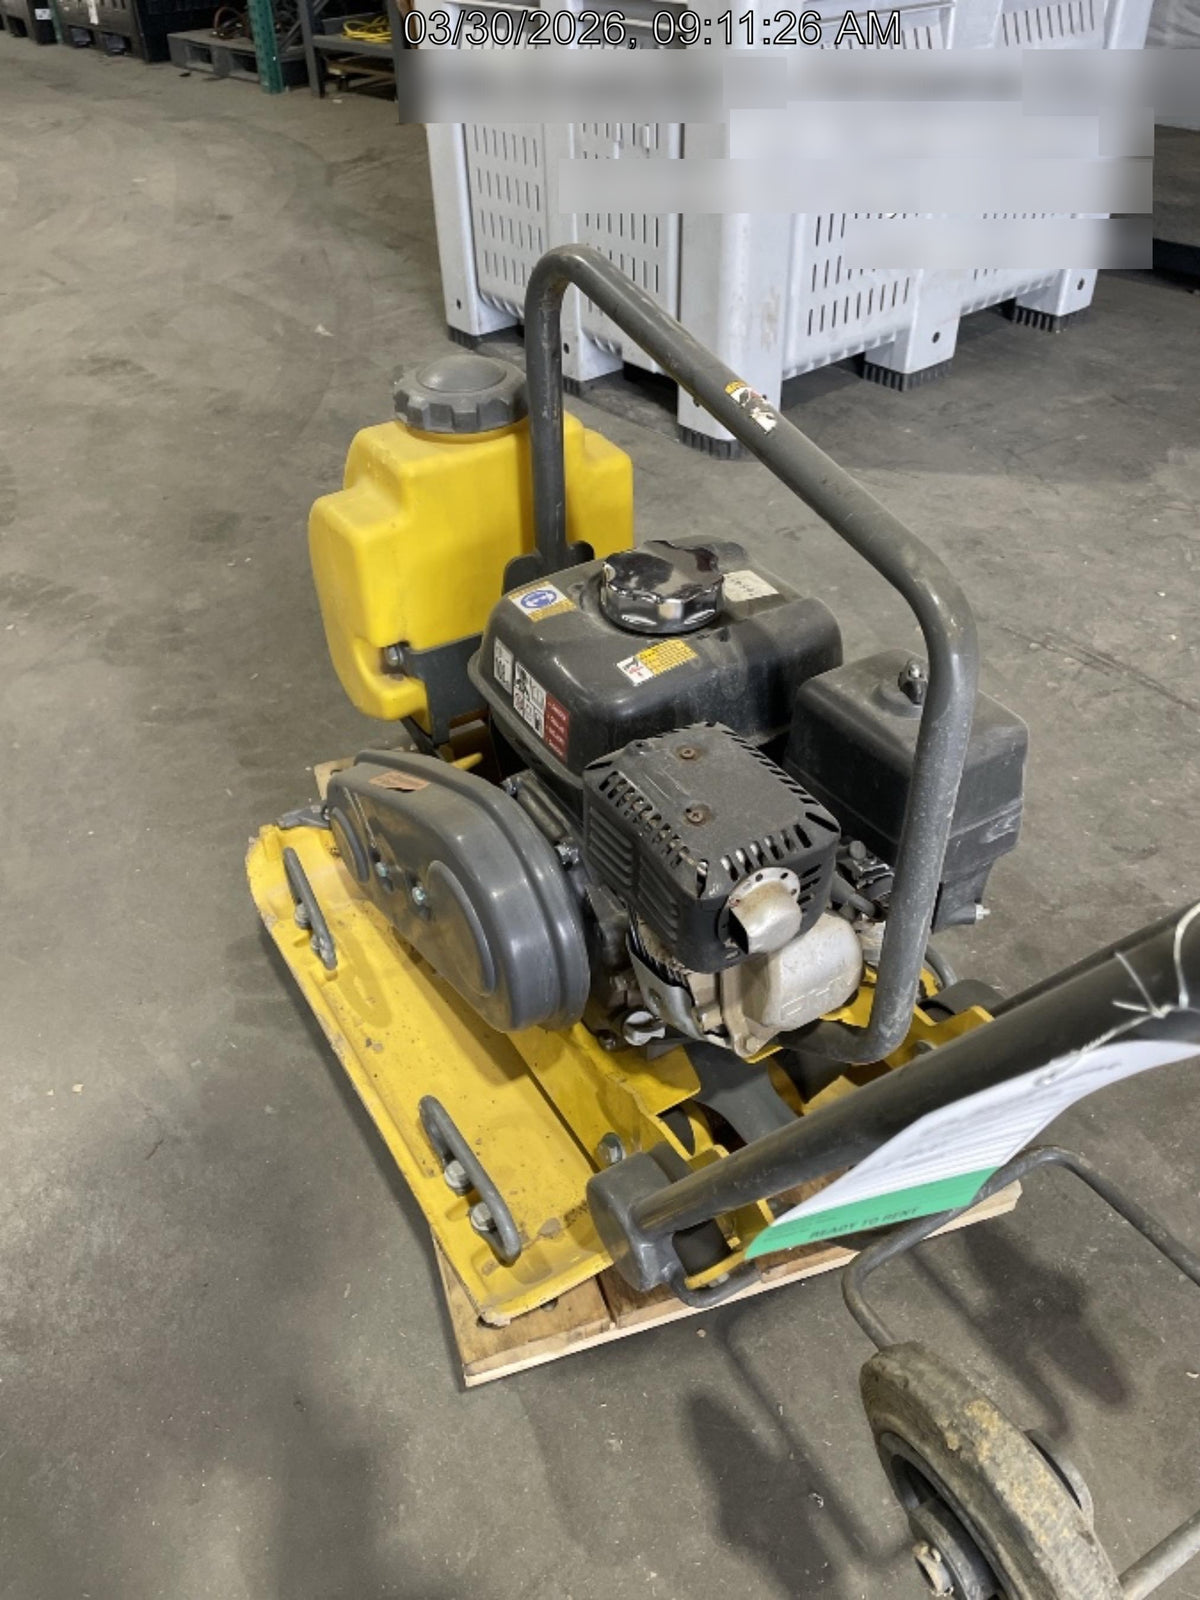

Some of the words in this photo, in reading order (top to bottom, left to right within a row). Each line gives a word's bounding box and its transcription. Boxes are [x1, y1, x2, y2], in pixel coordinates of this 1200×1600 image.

[809, 1221, 857, 1239] READY
[862, 1215, 880, 1226] TO
[882, 1206, 920, 1222] RENT
